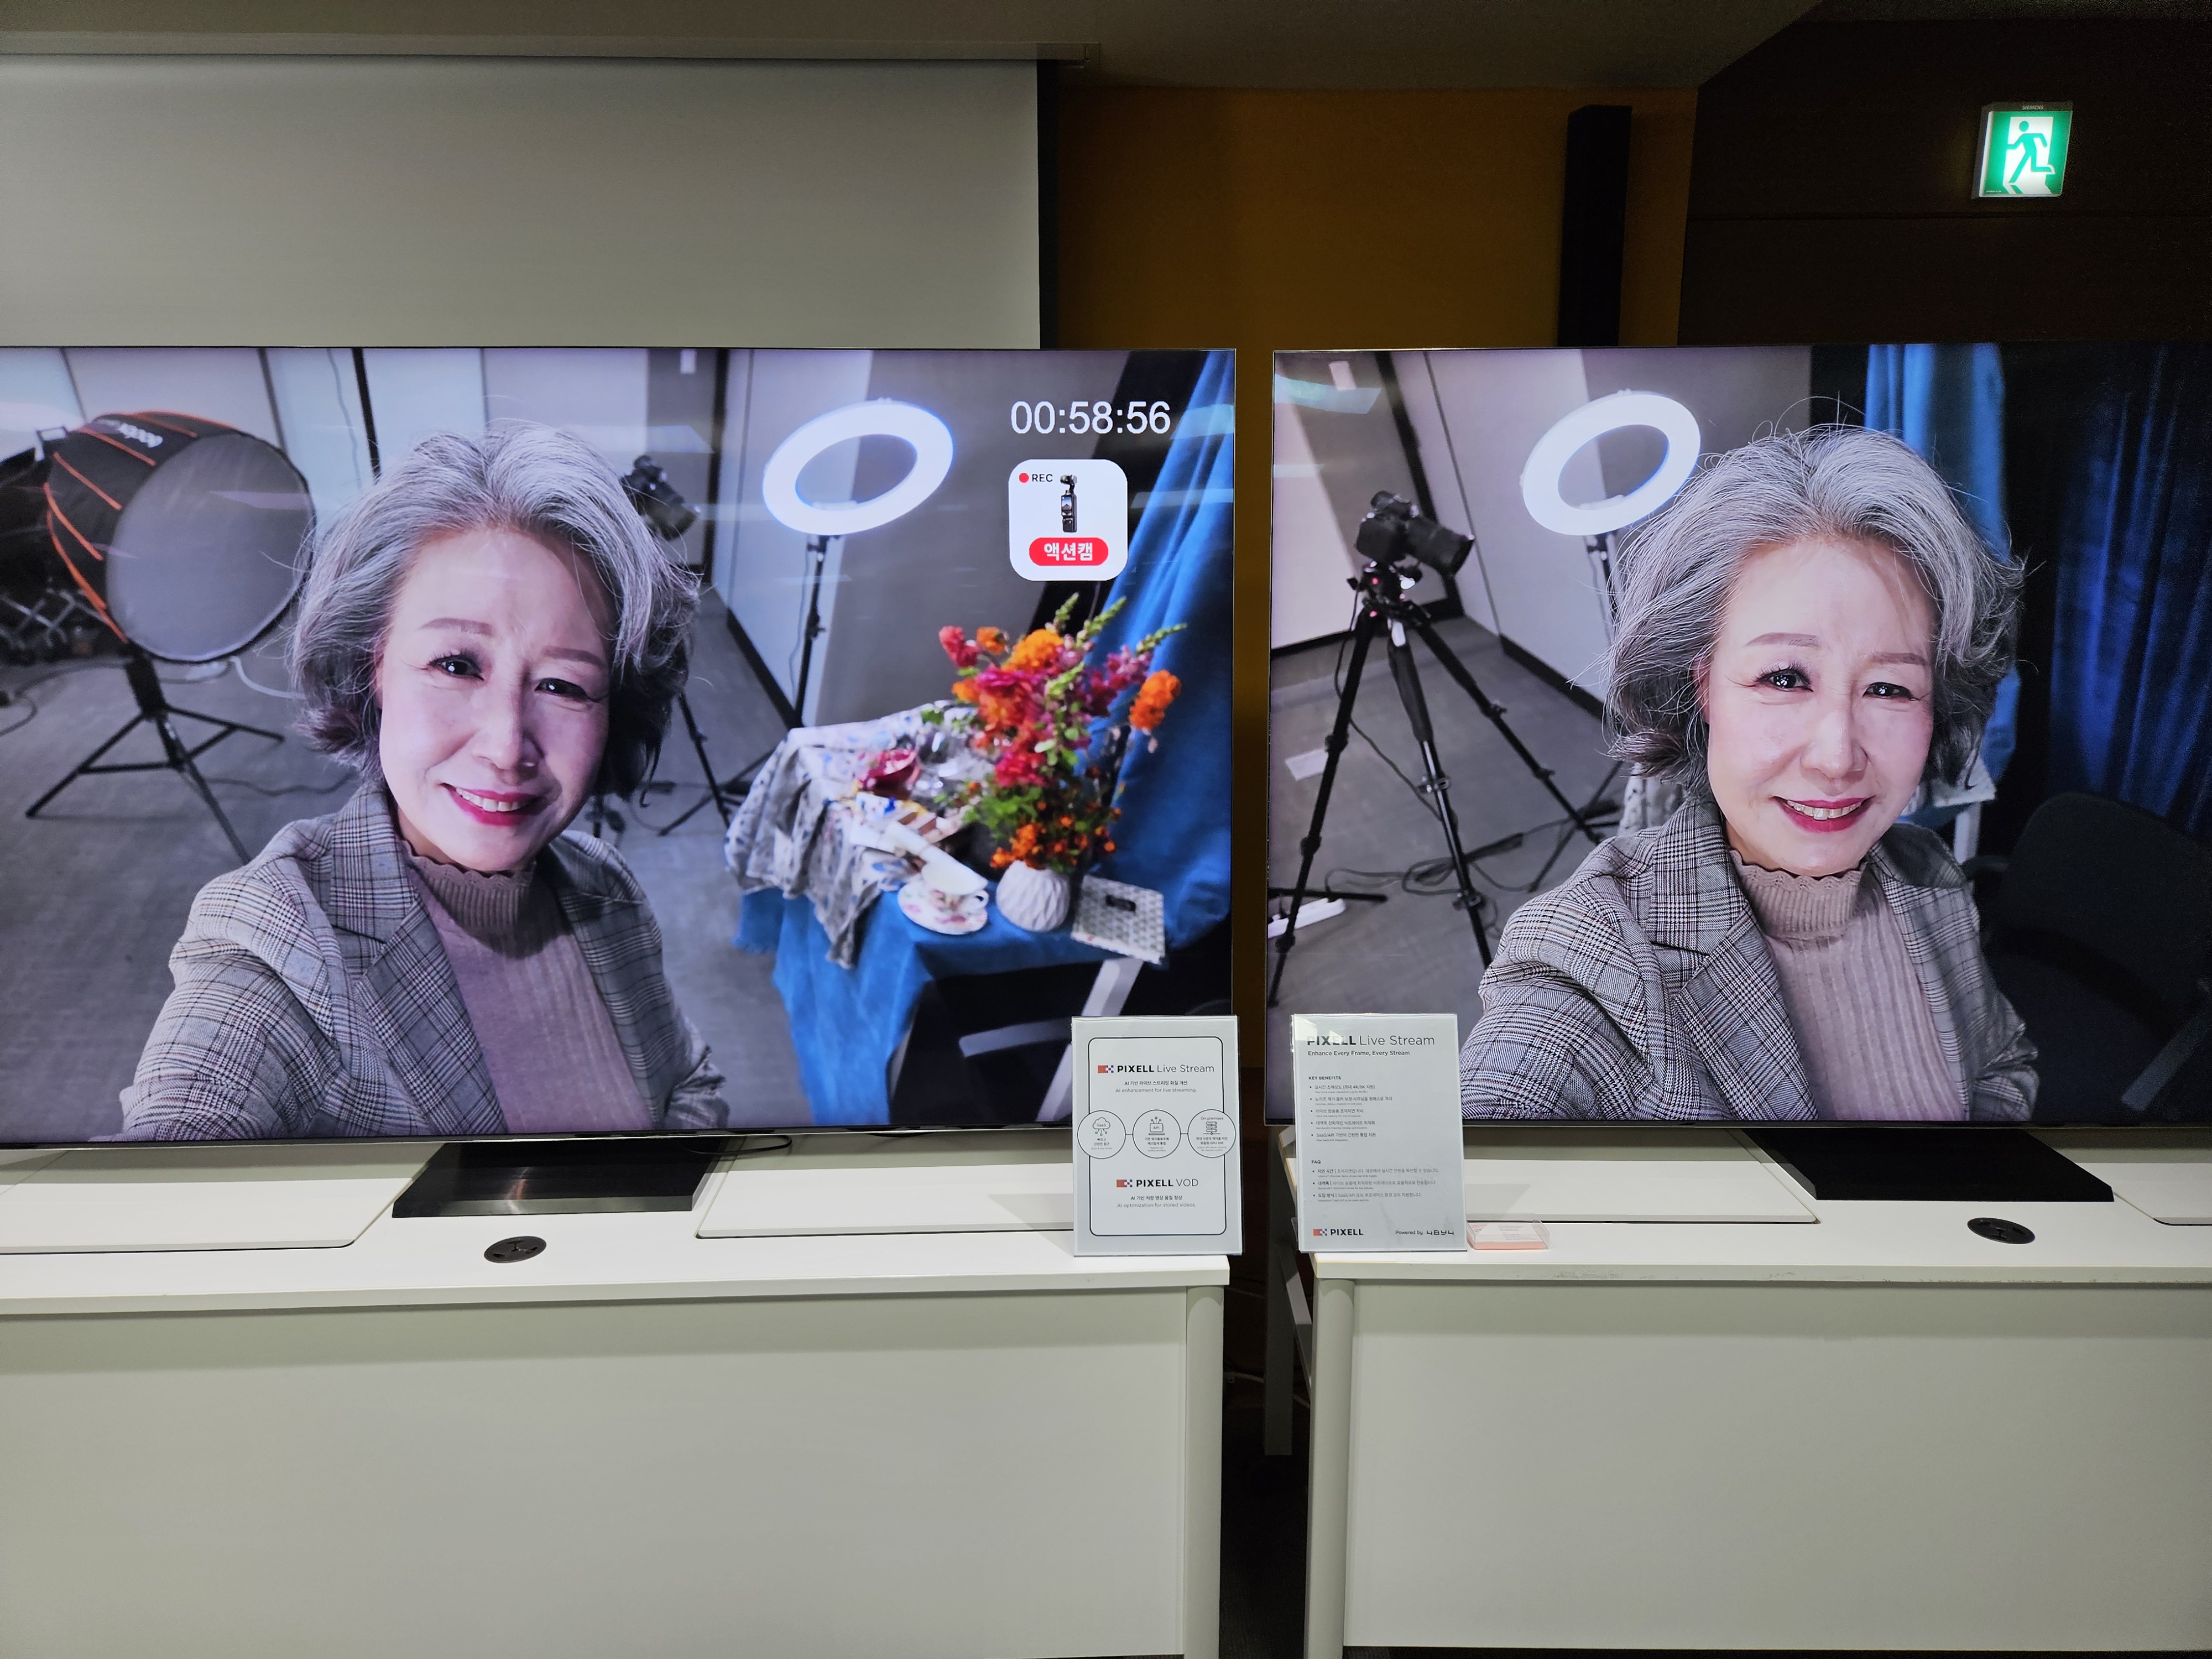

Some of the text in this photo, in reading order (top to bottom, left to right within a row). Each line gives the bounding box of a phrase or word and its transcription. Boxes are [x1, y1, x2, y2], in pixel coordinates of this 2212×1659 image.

[1011, 401, 1171, 434] 00:58:56
[1032, 474, 1053, 482] REC
[1044, 542, 1093, 561] 액션캠
[1307, 1035, 1434, 1045] PIXELL Live Stream
[1117, 1065, 1214, 1073] PIXELL Live Stream
[1176, 1178, 1199, 1187] VOD
